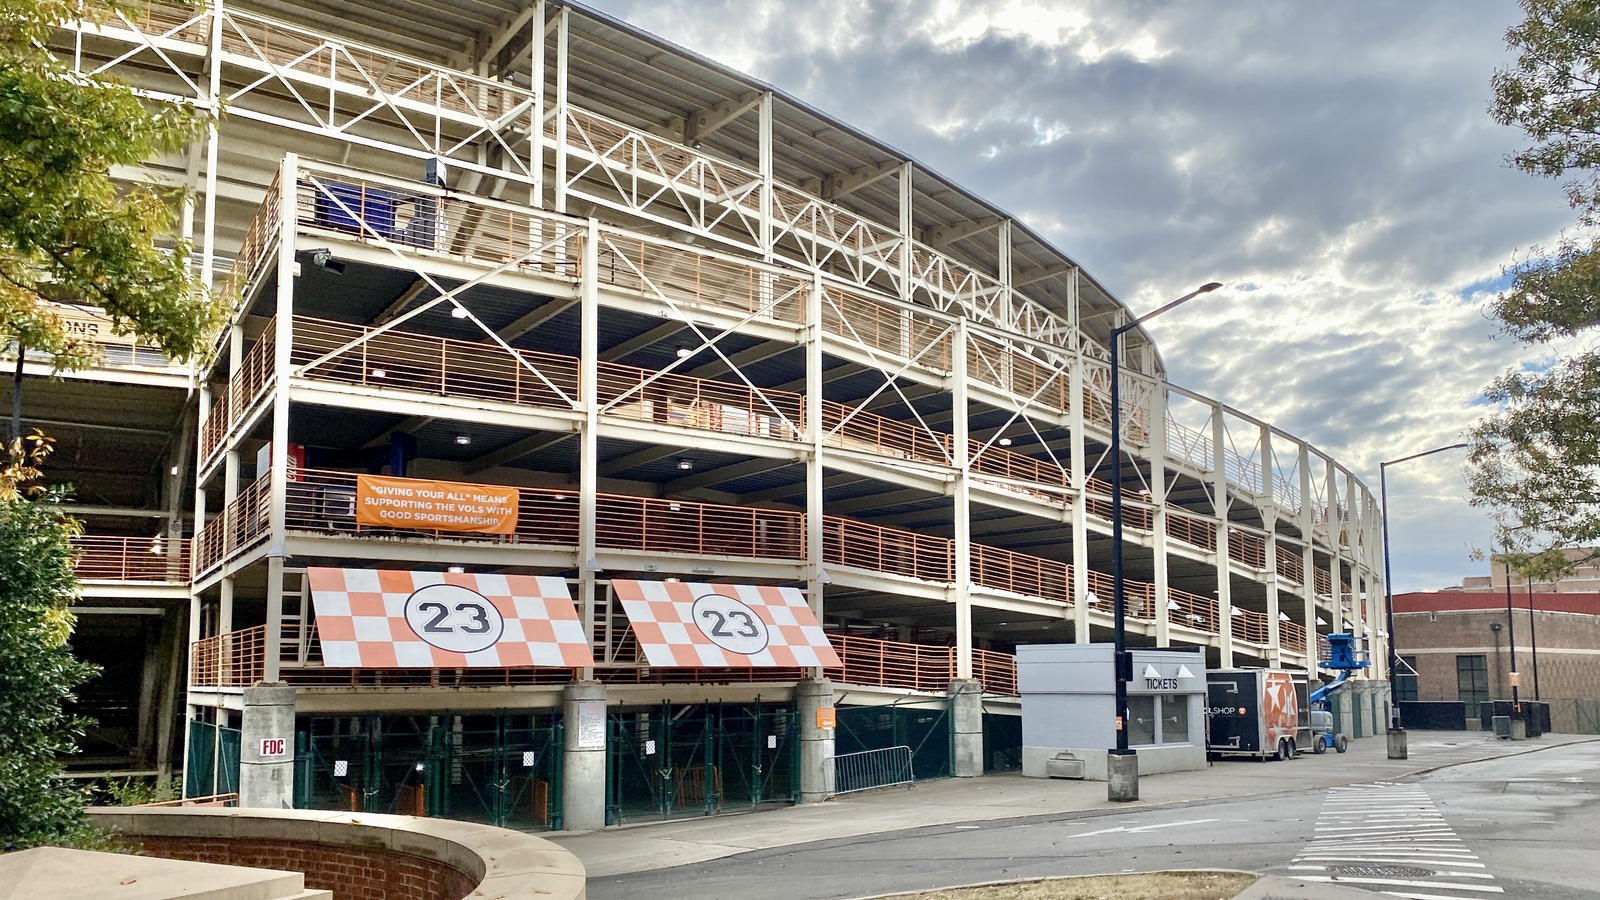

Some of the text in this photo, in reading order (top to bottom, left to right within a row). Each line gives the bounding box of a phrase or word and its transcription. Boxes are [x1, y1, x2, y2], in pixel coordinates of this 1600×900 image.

[416, 490, 444, 499] YOUR
[473, 495, 507, 504] MEANS
[365, 497, 432, 509] SUPPORTING
[435, 503, 455, 512] THE
[458, 505, 483, 514] VOLS
[487, 507, 512, 515] WITH
[380, 510, 500, 526] GOOD SPORTSMANSHIP.
[417, 602, 492, 634] 23
[702, 609, 760, 638] 23
[1146, 678, 1178, 689] TICKETS
[263, 739, 284, 754] FDC
